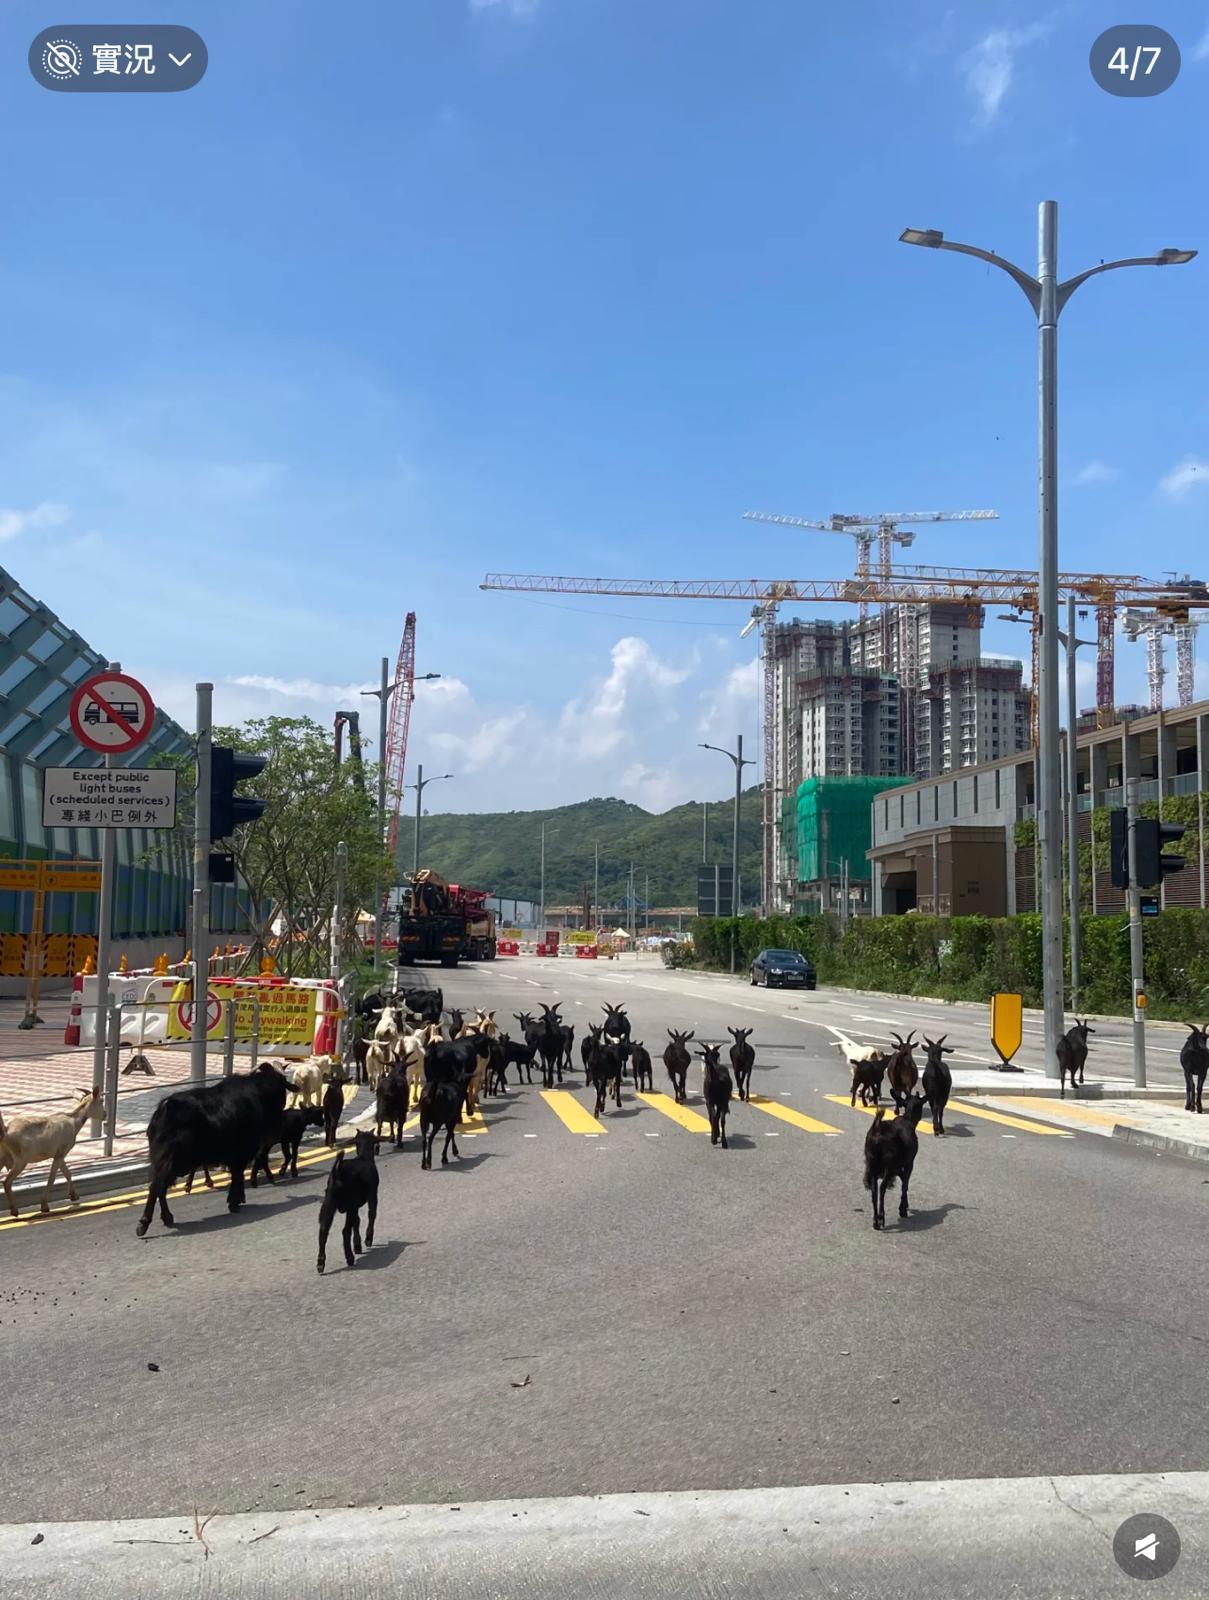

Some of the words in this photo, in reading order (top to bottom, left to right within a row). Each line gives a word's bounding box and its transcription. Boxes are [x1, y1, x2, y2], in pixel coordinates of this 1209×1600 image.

[72, 771, 113, 782] Except
[115, 773, 150, 782] public
[79, 783, 106, 794] light
[108, 783, 142, 793] buses
[49, 794, 115, 806] (scheduled
[117, 795, 170, 807] services)
[247, 1015, 308, 1027] Jywalking
